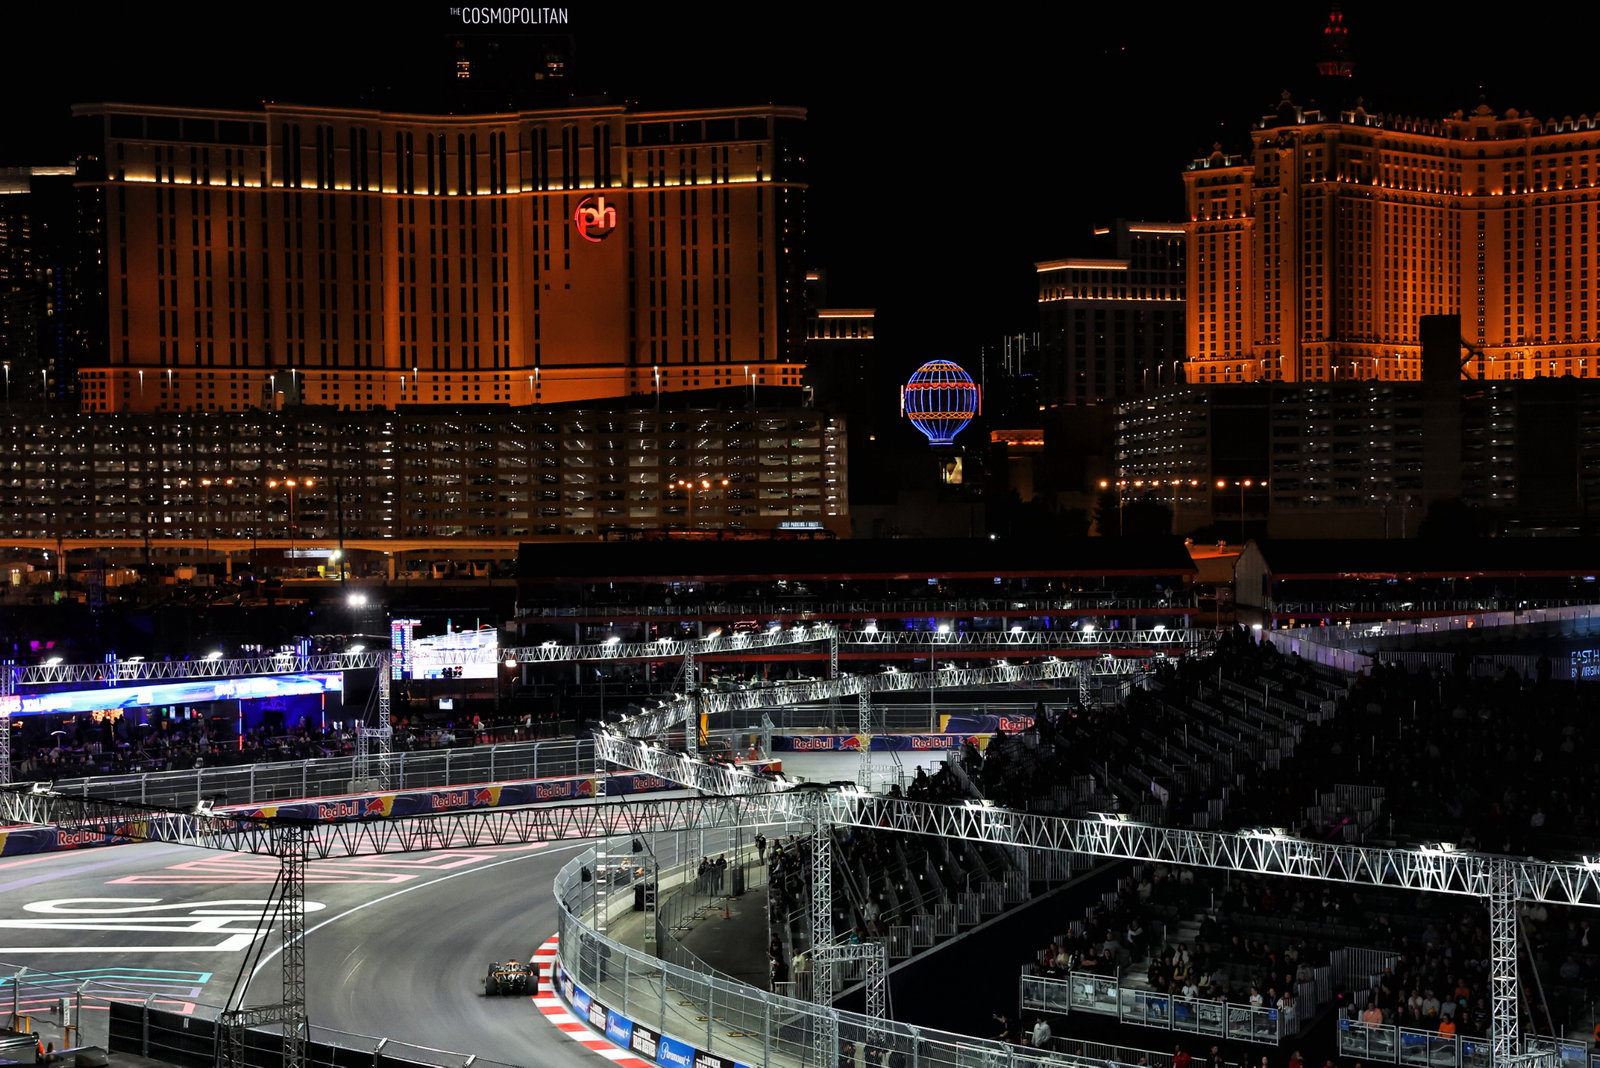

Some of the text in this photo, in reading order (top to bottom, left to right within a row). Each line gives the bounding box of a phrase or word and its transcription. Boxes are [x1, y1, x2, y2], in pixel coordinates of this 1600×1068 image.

[450, 7, 568, 24] THE COSMOPOLITAN
[577, 196, 616, 239] ph
[1571, 649, 1592, 665] EAST
[999, 716, 1026, 730] Red
[793, 737, 834, 750] Red Bull
[911, 736, 953, 749] Red Bull
[536, 781, 572, 799] Red Bull
[633, 775, 666, 790] Red Bull
[432, 791, 469, 808] Red Bull
[318, 800, 359, 819] Red Bull
[57, 824, 106, 846] Red Bull
[660, 1041, 691, 1067] Paramount+
